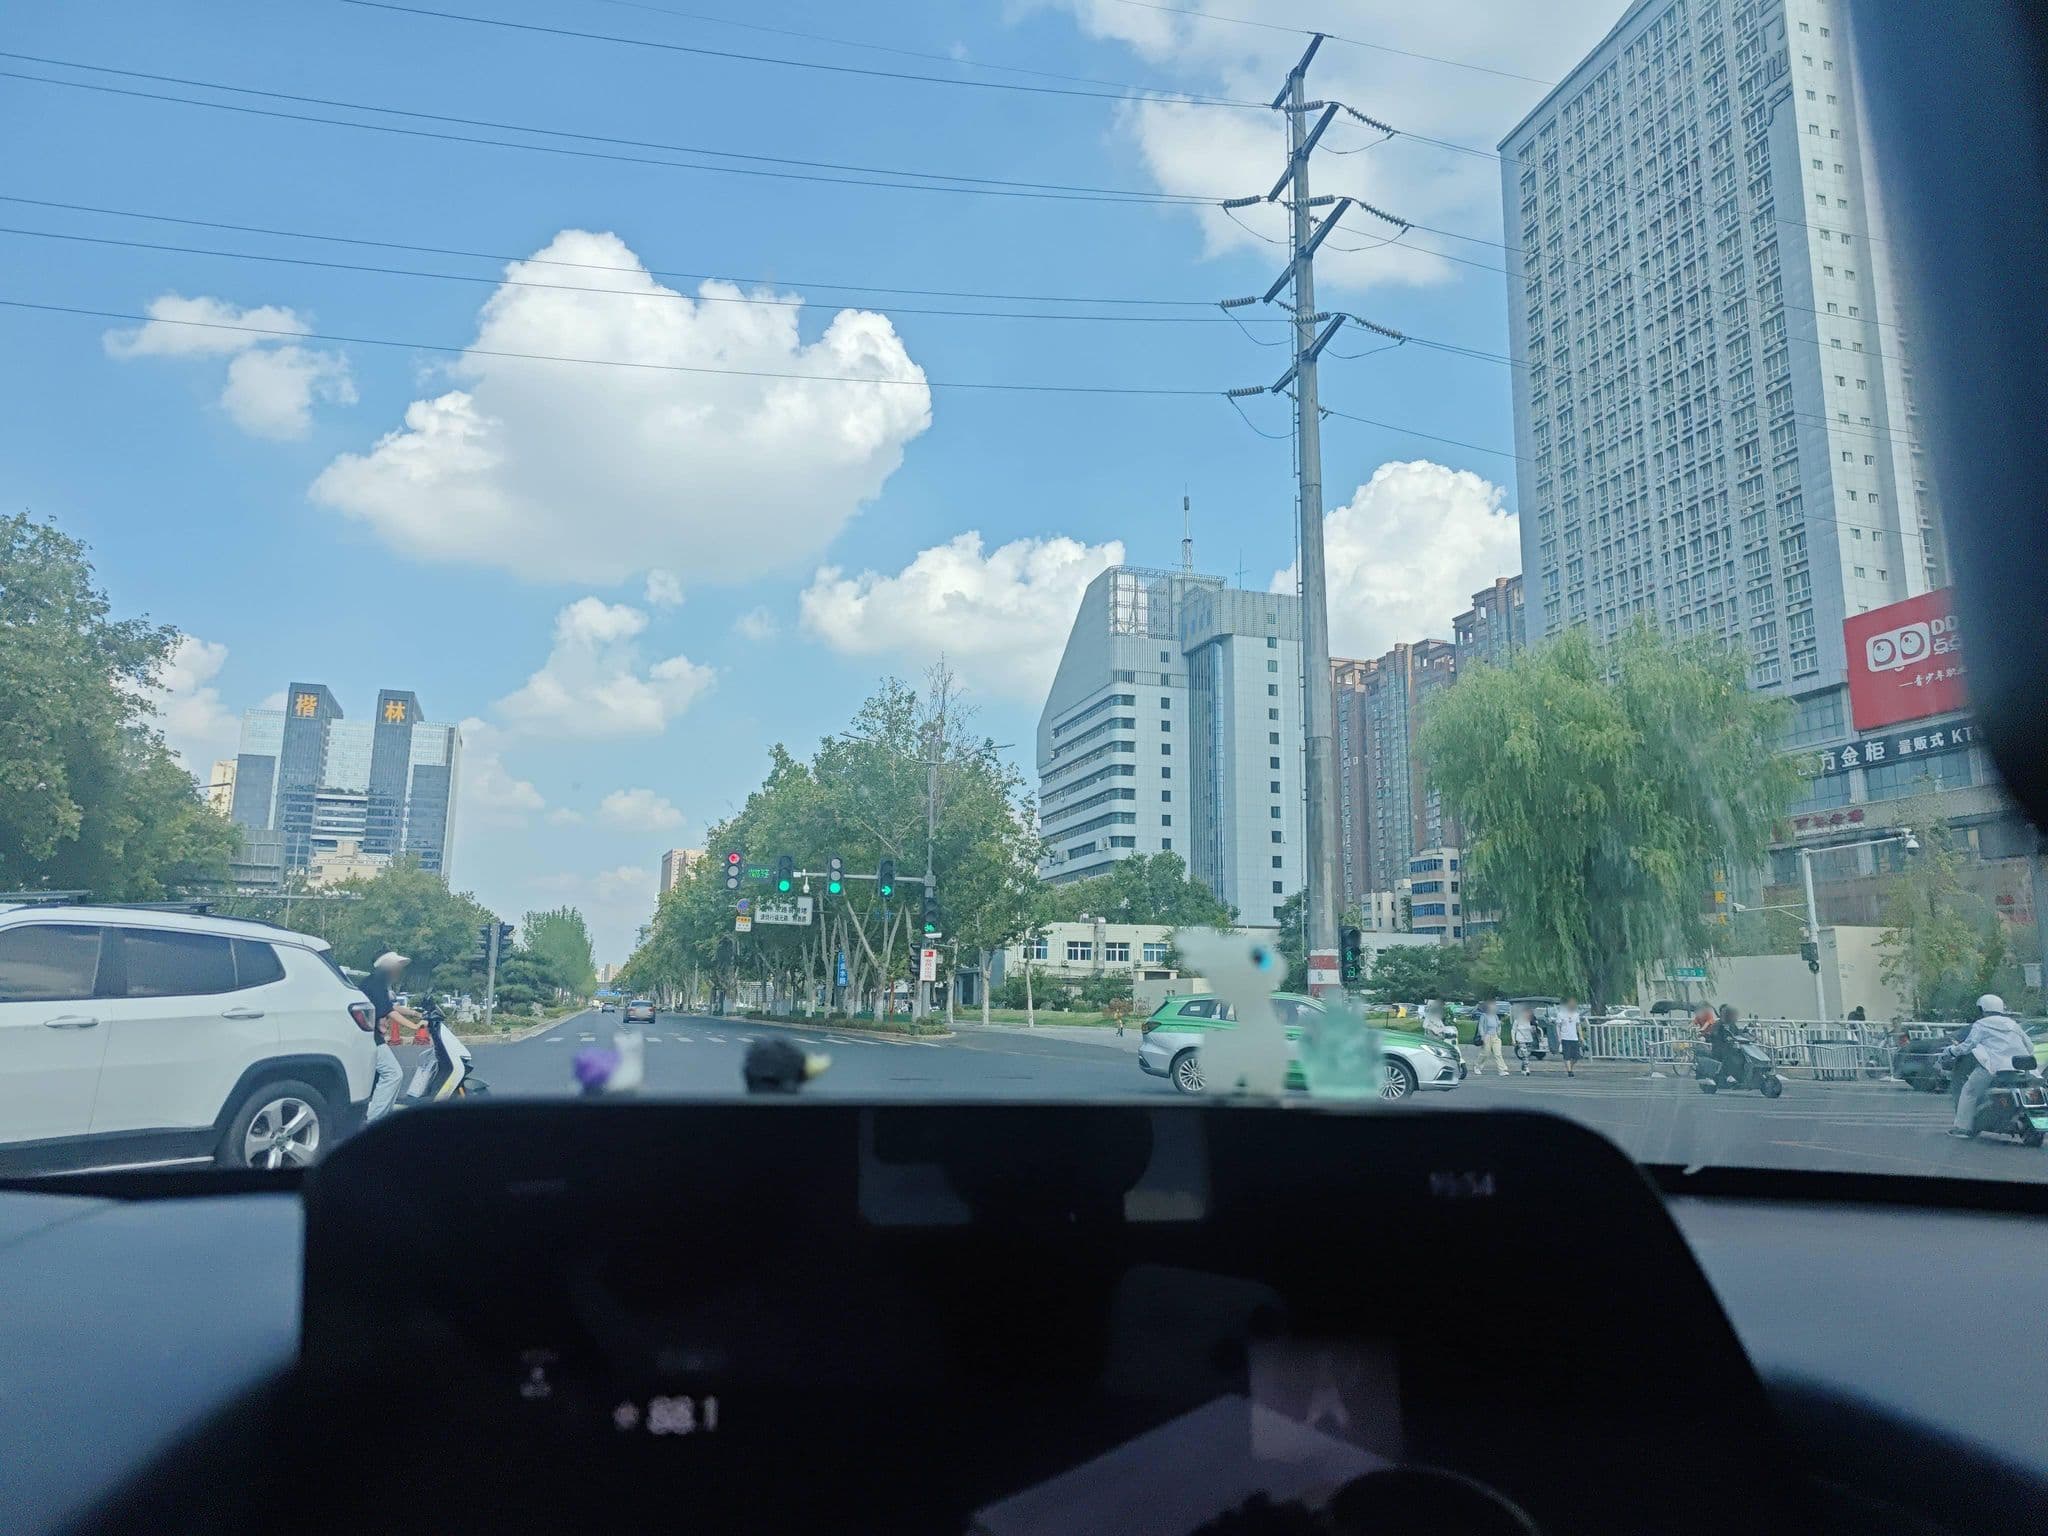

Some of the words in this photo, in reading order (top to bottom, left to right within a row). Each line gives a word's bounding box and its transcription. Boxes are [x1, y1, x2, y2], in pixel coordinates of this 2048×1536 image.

[296, 694, 318, 717] 楷
[385, 700, 406, 723] 林
[1897, 732, 1945, 755] 量贩式
